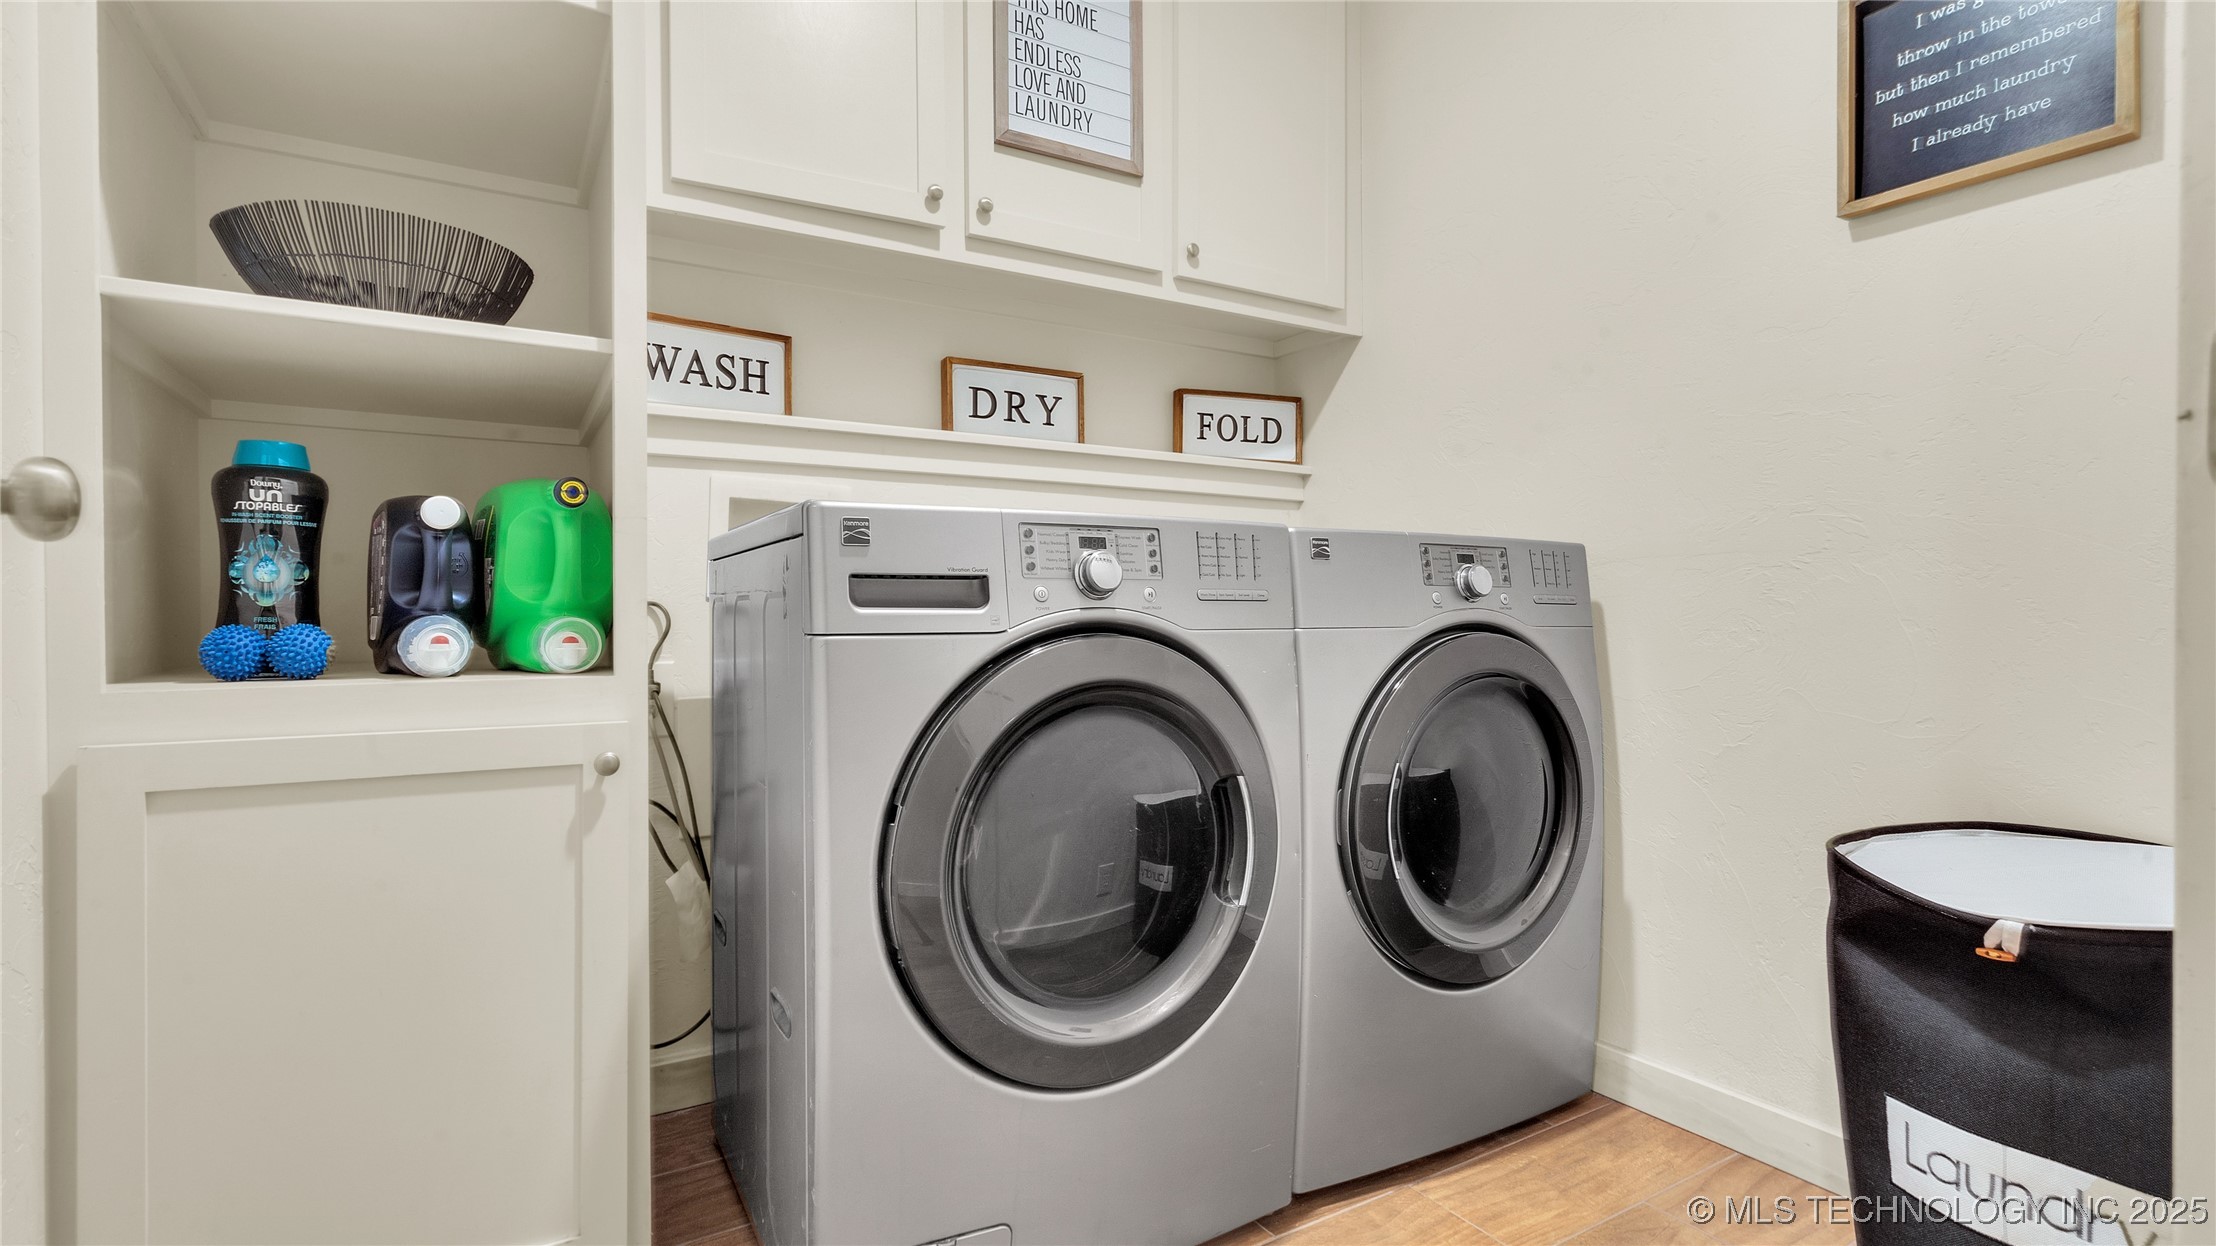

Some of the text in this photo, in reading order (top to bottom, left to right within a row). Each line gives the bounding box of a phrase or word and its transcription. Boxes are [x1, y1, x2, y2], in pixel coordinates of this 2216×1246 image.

[1014, 9, 1045, 41] HAS
[1055, 0, 1098, 32] HOME
[1897, 0, 2067, 68] throw in the tow
[1916, 14, 1924, 30] I
[1930, 0, 1966, 21] was
[1014, 37, 1082, 78] ENDLESS
[1874, 6, 2104, 106] but then I remembered
[1014, 64, 1087, 105] LOVE AND
[1891, 54, 2078, 128] how much laundry
[1014, 91, 1093, 133] LAUNDRY
[1911, 97, 2052, 153] I already have
[647, 342, 770, 395] WASH
[968, 386, 1062, 427] DRY
[1196, 412, 1283, 445] FOLD
[249, 478, 283, 490] Downy
[233, 501, 303, 513] STOPABLES
